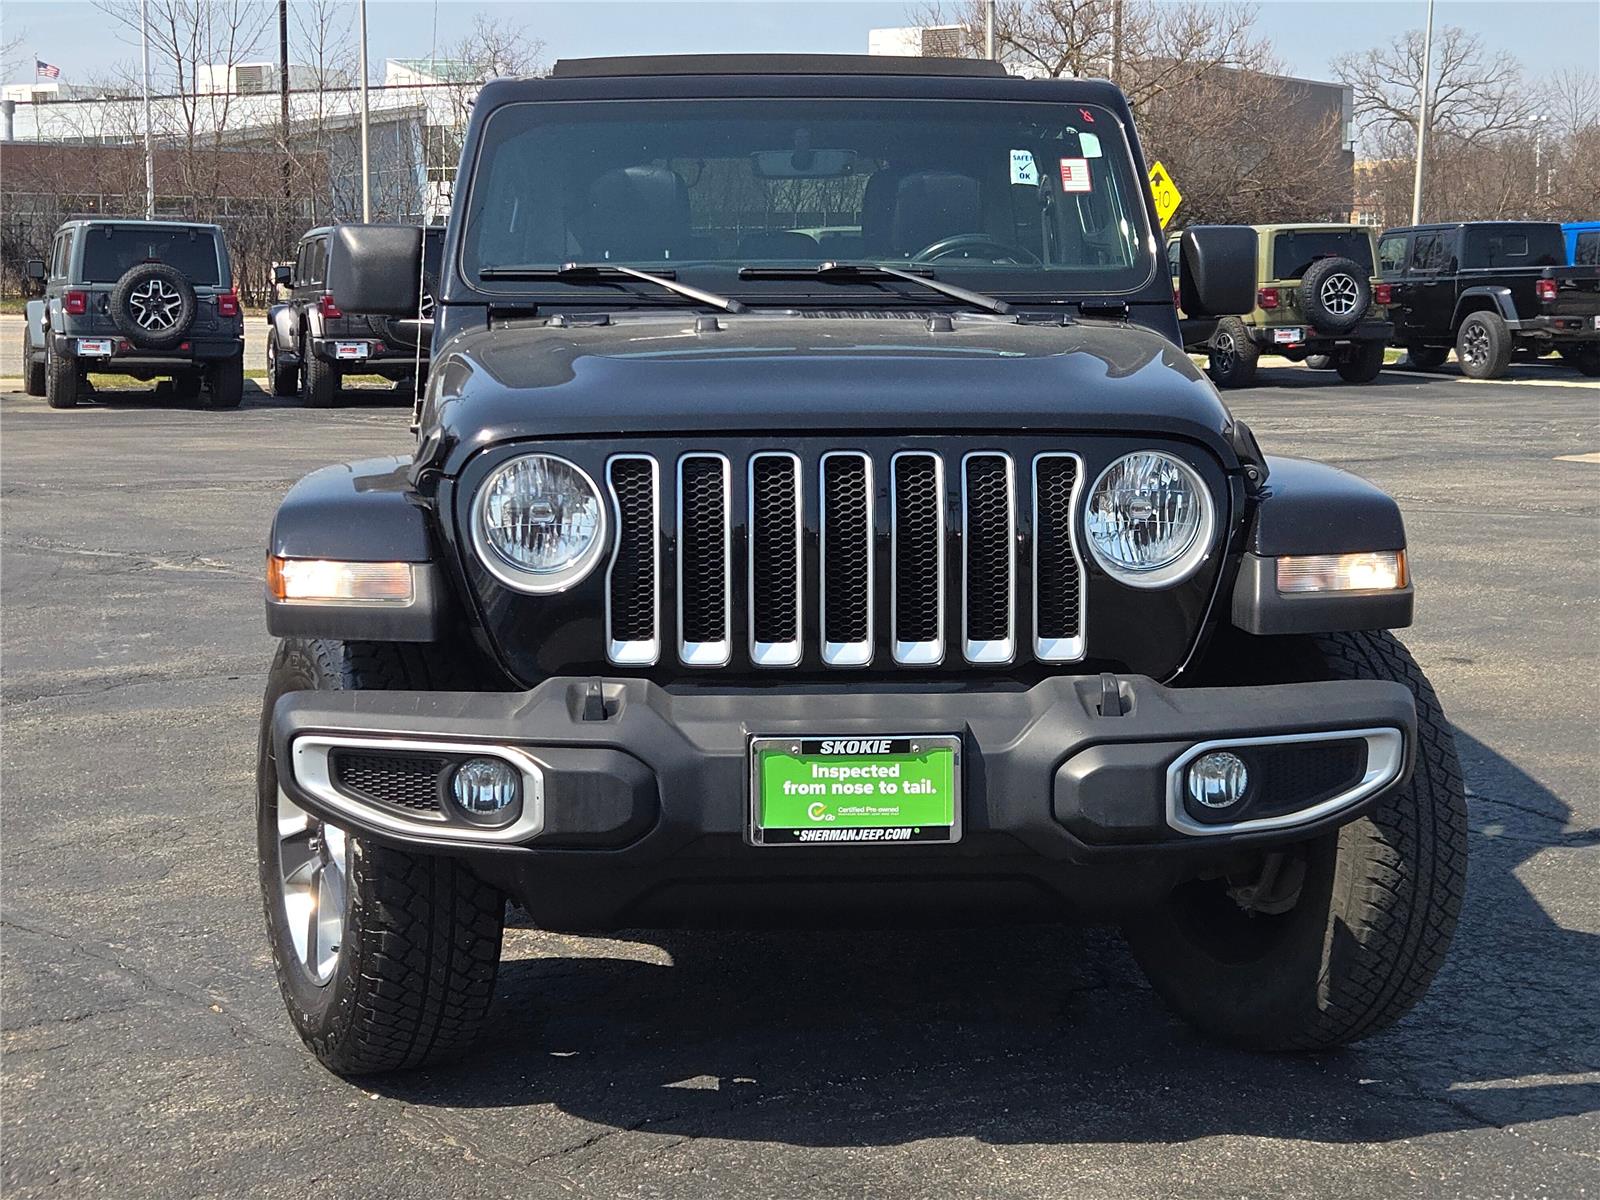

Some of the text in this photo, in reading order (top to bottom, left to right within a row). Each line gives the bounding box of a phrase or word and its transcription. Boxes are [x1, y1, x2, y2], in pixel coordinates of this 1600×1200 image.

[1012, 154, 1034, 162] SAFET
[1019, 172, 1031, 180] OK
[820, 740, 891, 754] SKOKIE
[812, 764, 900, 781] Inspected
[783, 779, 937, 795] from nose to tail.
[838, 804, 865, 812] Certified
[799, 827, 912, 842] SHERMANJEEP.COM
